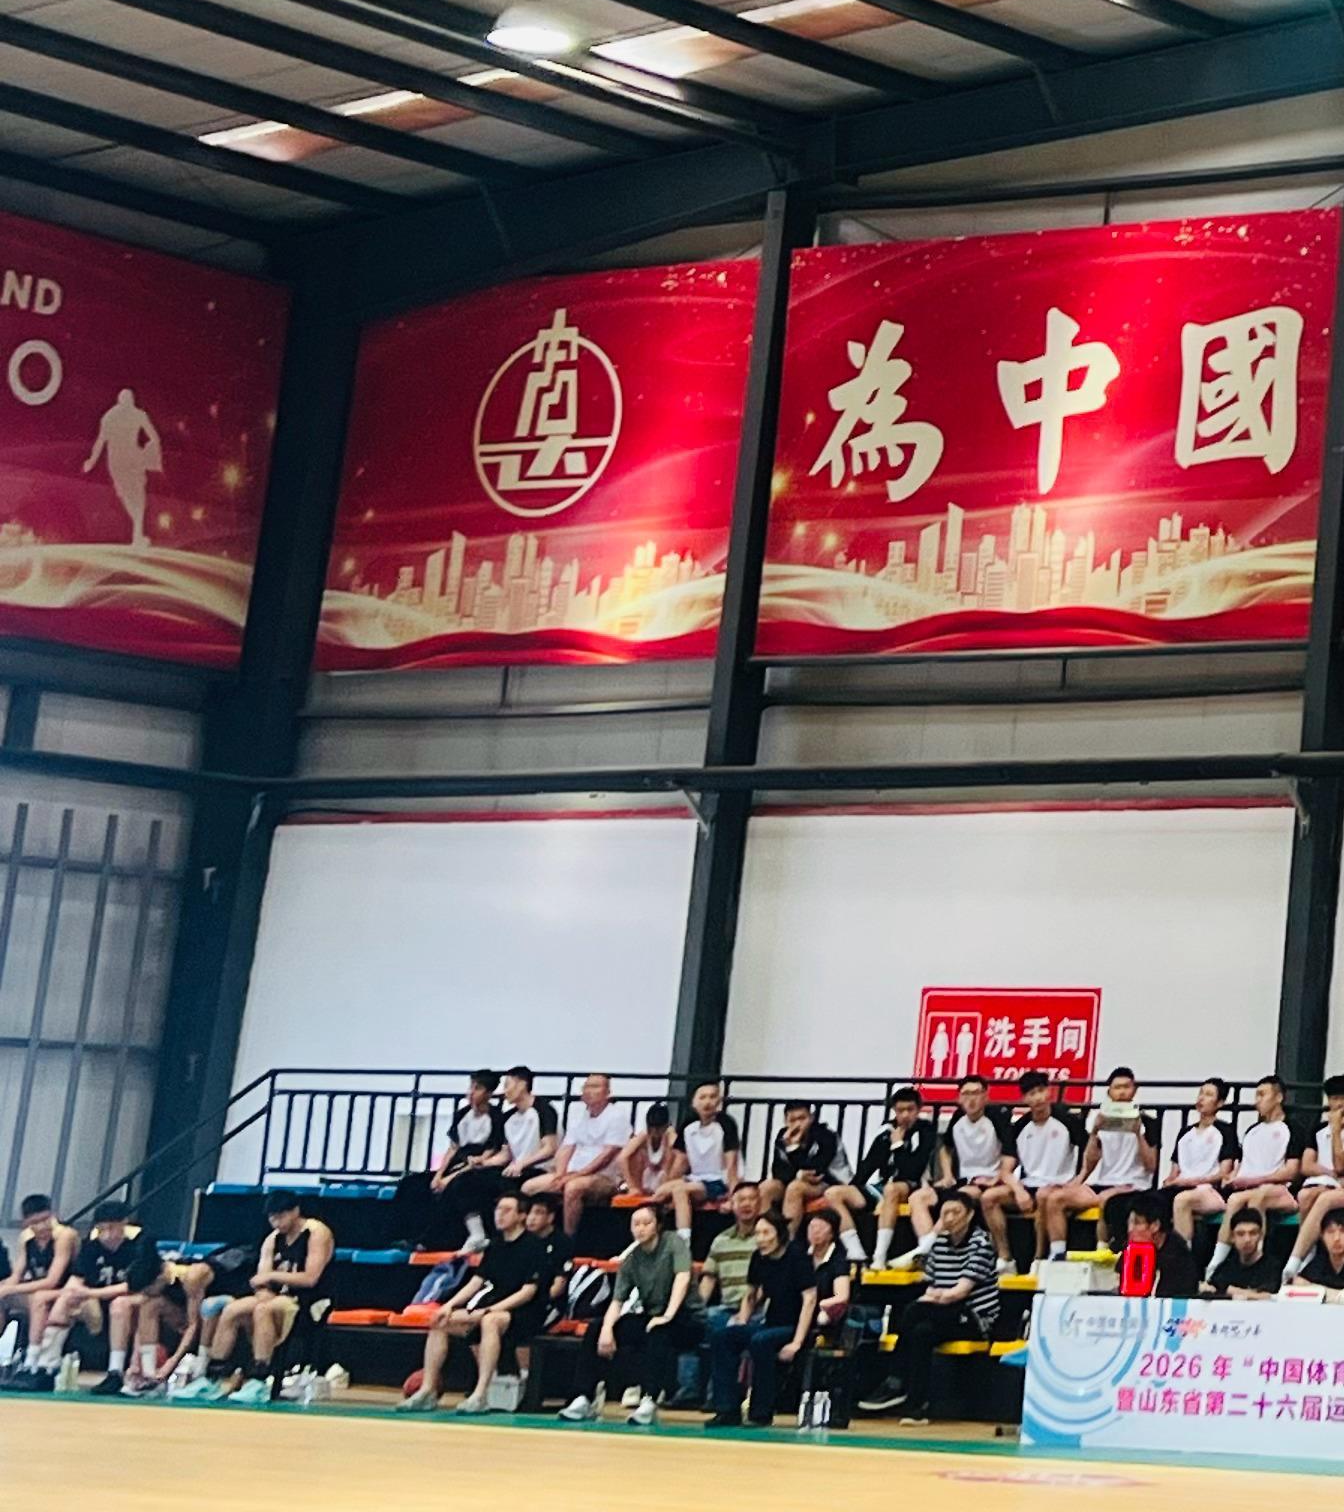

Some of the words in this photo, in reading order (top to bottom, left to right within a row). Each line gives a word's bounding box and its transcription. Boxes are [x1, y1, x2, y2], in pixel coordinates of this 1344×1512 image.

[808, 306, 1304, 503] 為中國
[983, 1015, 1088, 1061] 洗手间
[1139, 1353, 1202, 1379] 2026
